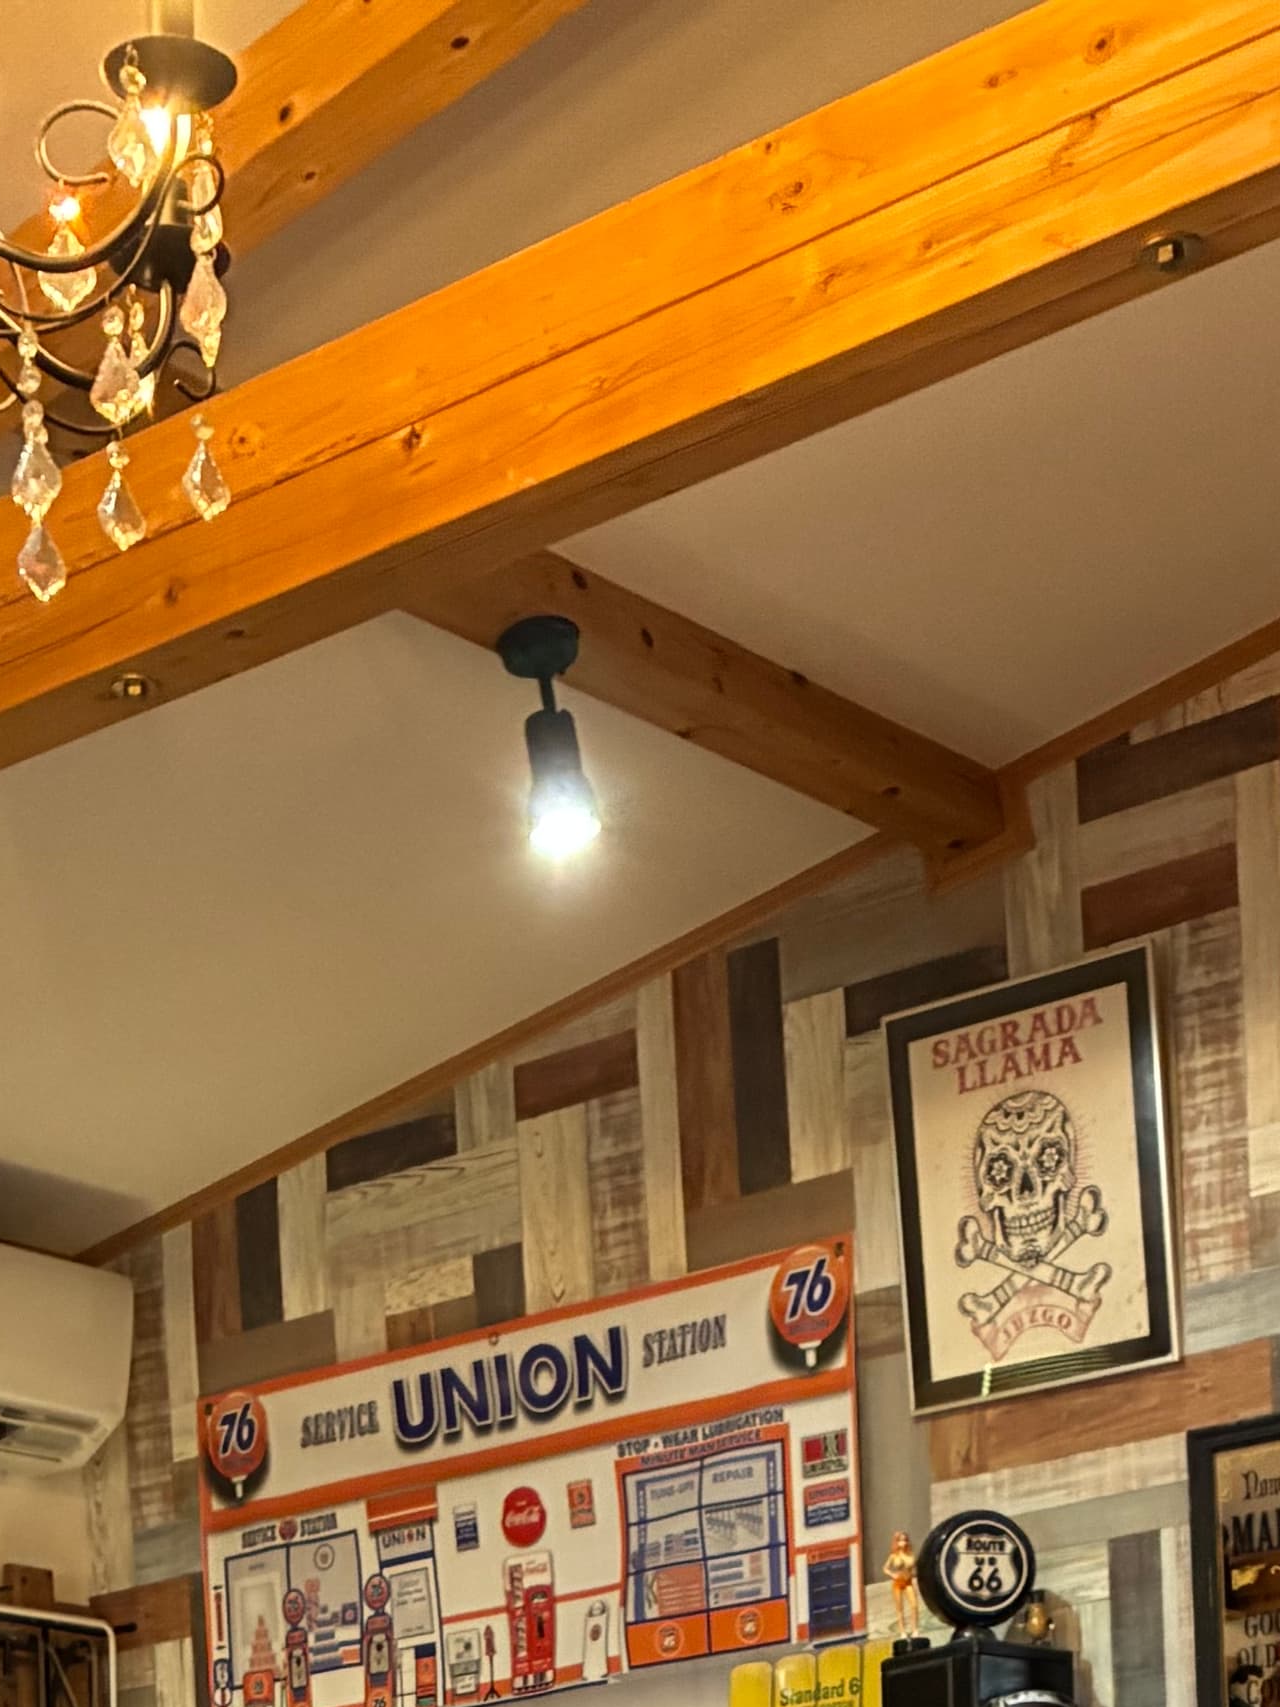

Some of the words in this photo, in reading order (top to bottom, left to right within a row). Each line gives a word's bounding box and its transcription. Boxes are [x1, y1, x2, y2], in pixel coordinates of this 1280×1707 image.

[931, 997, 1103, 1070] SAGRADA
[955, 1038, 1083, 1095] LLAMA
[782, 1256, 835, 1324] 76
[299, 1401, 380, 1449] SERVICE
[390, 1325, 627, 1444] UNION
[642, 1313, 727, 1369] STATION
[219, 1402, 257, 1456] 76
[968, 1567, 1003, 1593] 66
[780, 1678, 845, 1707] Standard
[849, 1676, 863, 1696] 6
